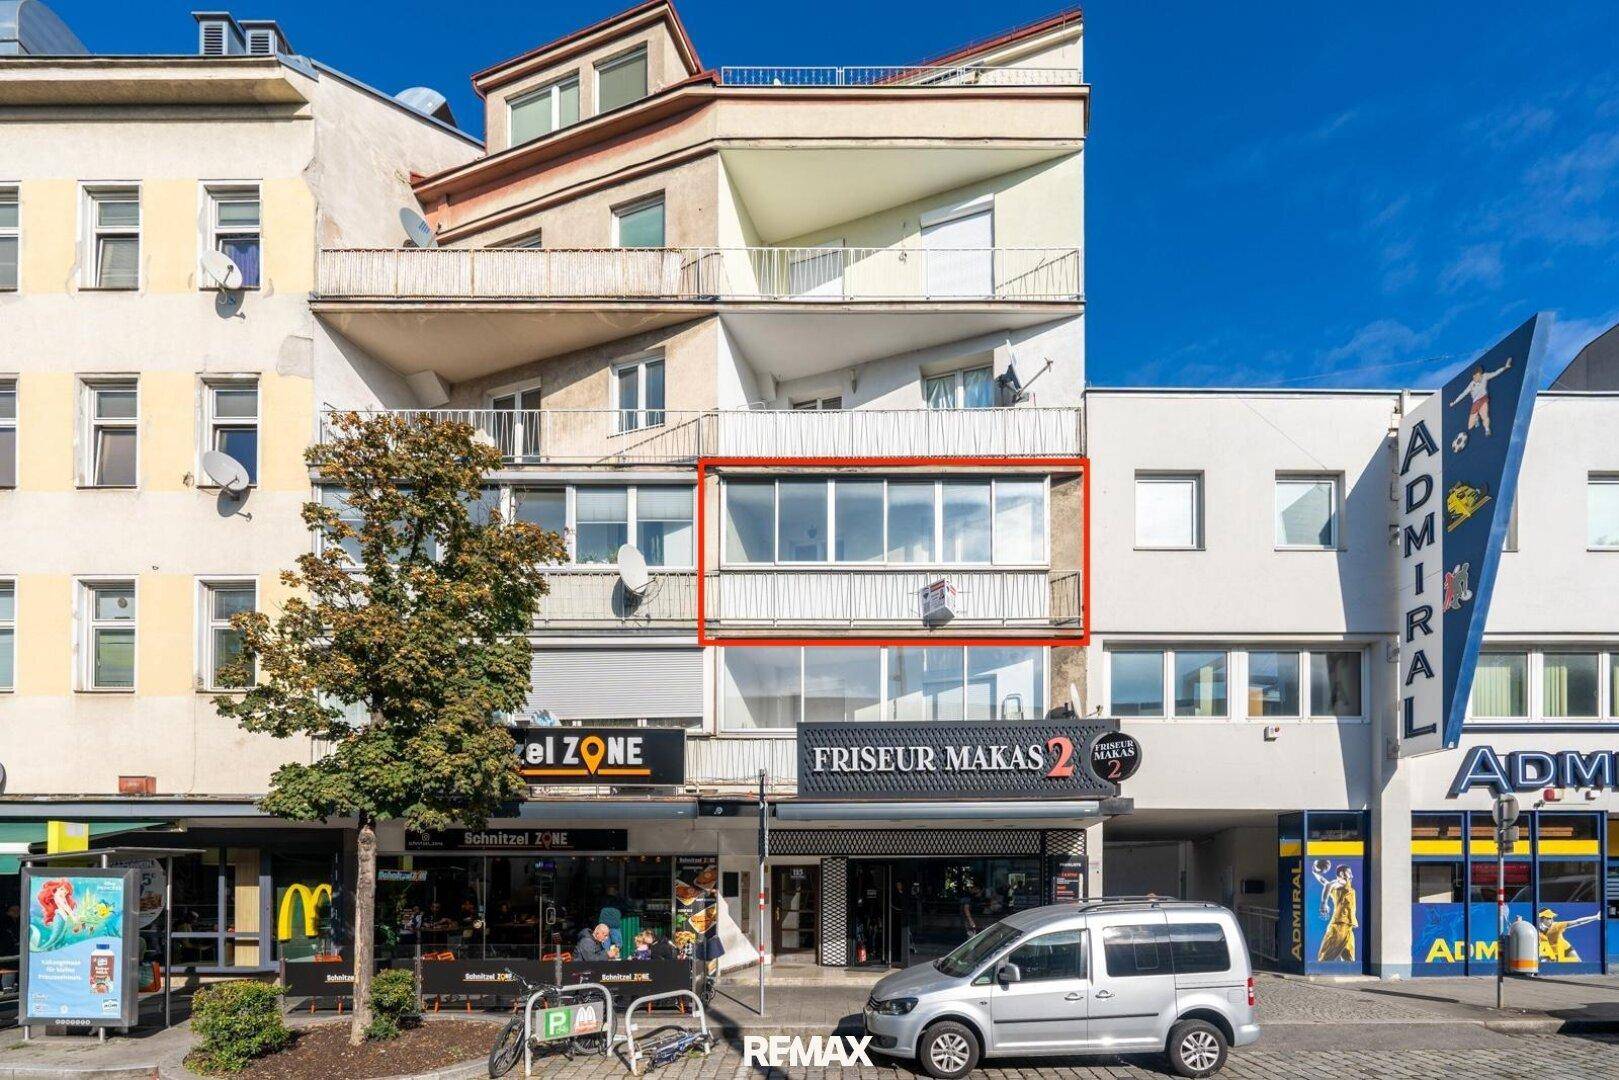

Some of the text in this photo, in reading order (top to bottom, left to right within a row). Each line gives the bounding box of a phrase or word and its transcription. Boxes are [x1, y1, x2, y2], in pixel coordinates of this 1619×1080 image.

[1400, 420, 1440, 739] ADMIRAL
[562, 735, 643, 775] ZONE
[813, 736, 1075, 779] FRISEUR MAKAS 2
[1094, 740, 1135, 761] FRISEUR MAKAS
[1107, 759, 1122, 779] 2
[1446, 745, 1619, 800] ADM
[464, 831, 568, 849] Schnitzel ZONE
[1291, 860, 1302, 961] ADMIRAL
[1425, 938, 1582, 963] ADMAL
[465, 973, 495, 981] Schnitzel
[601, 973, 632, 981] Schnitzel
[549, 1012, 567, 1035] P
